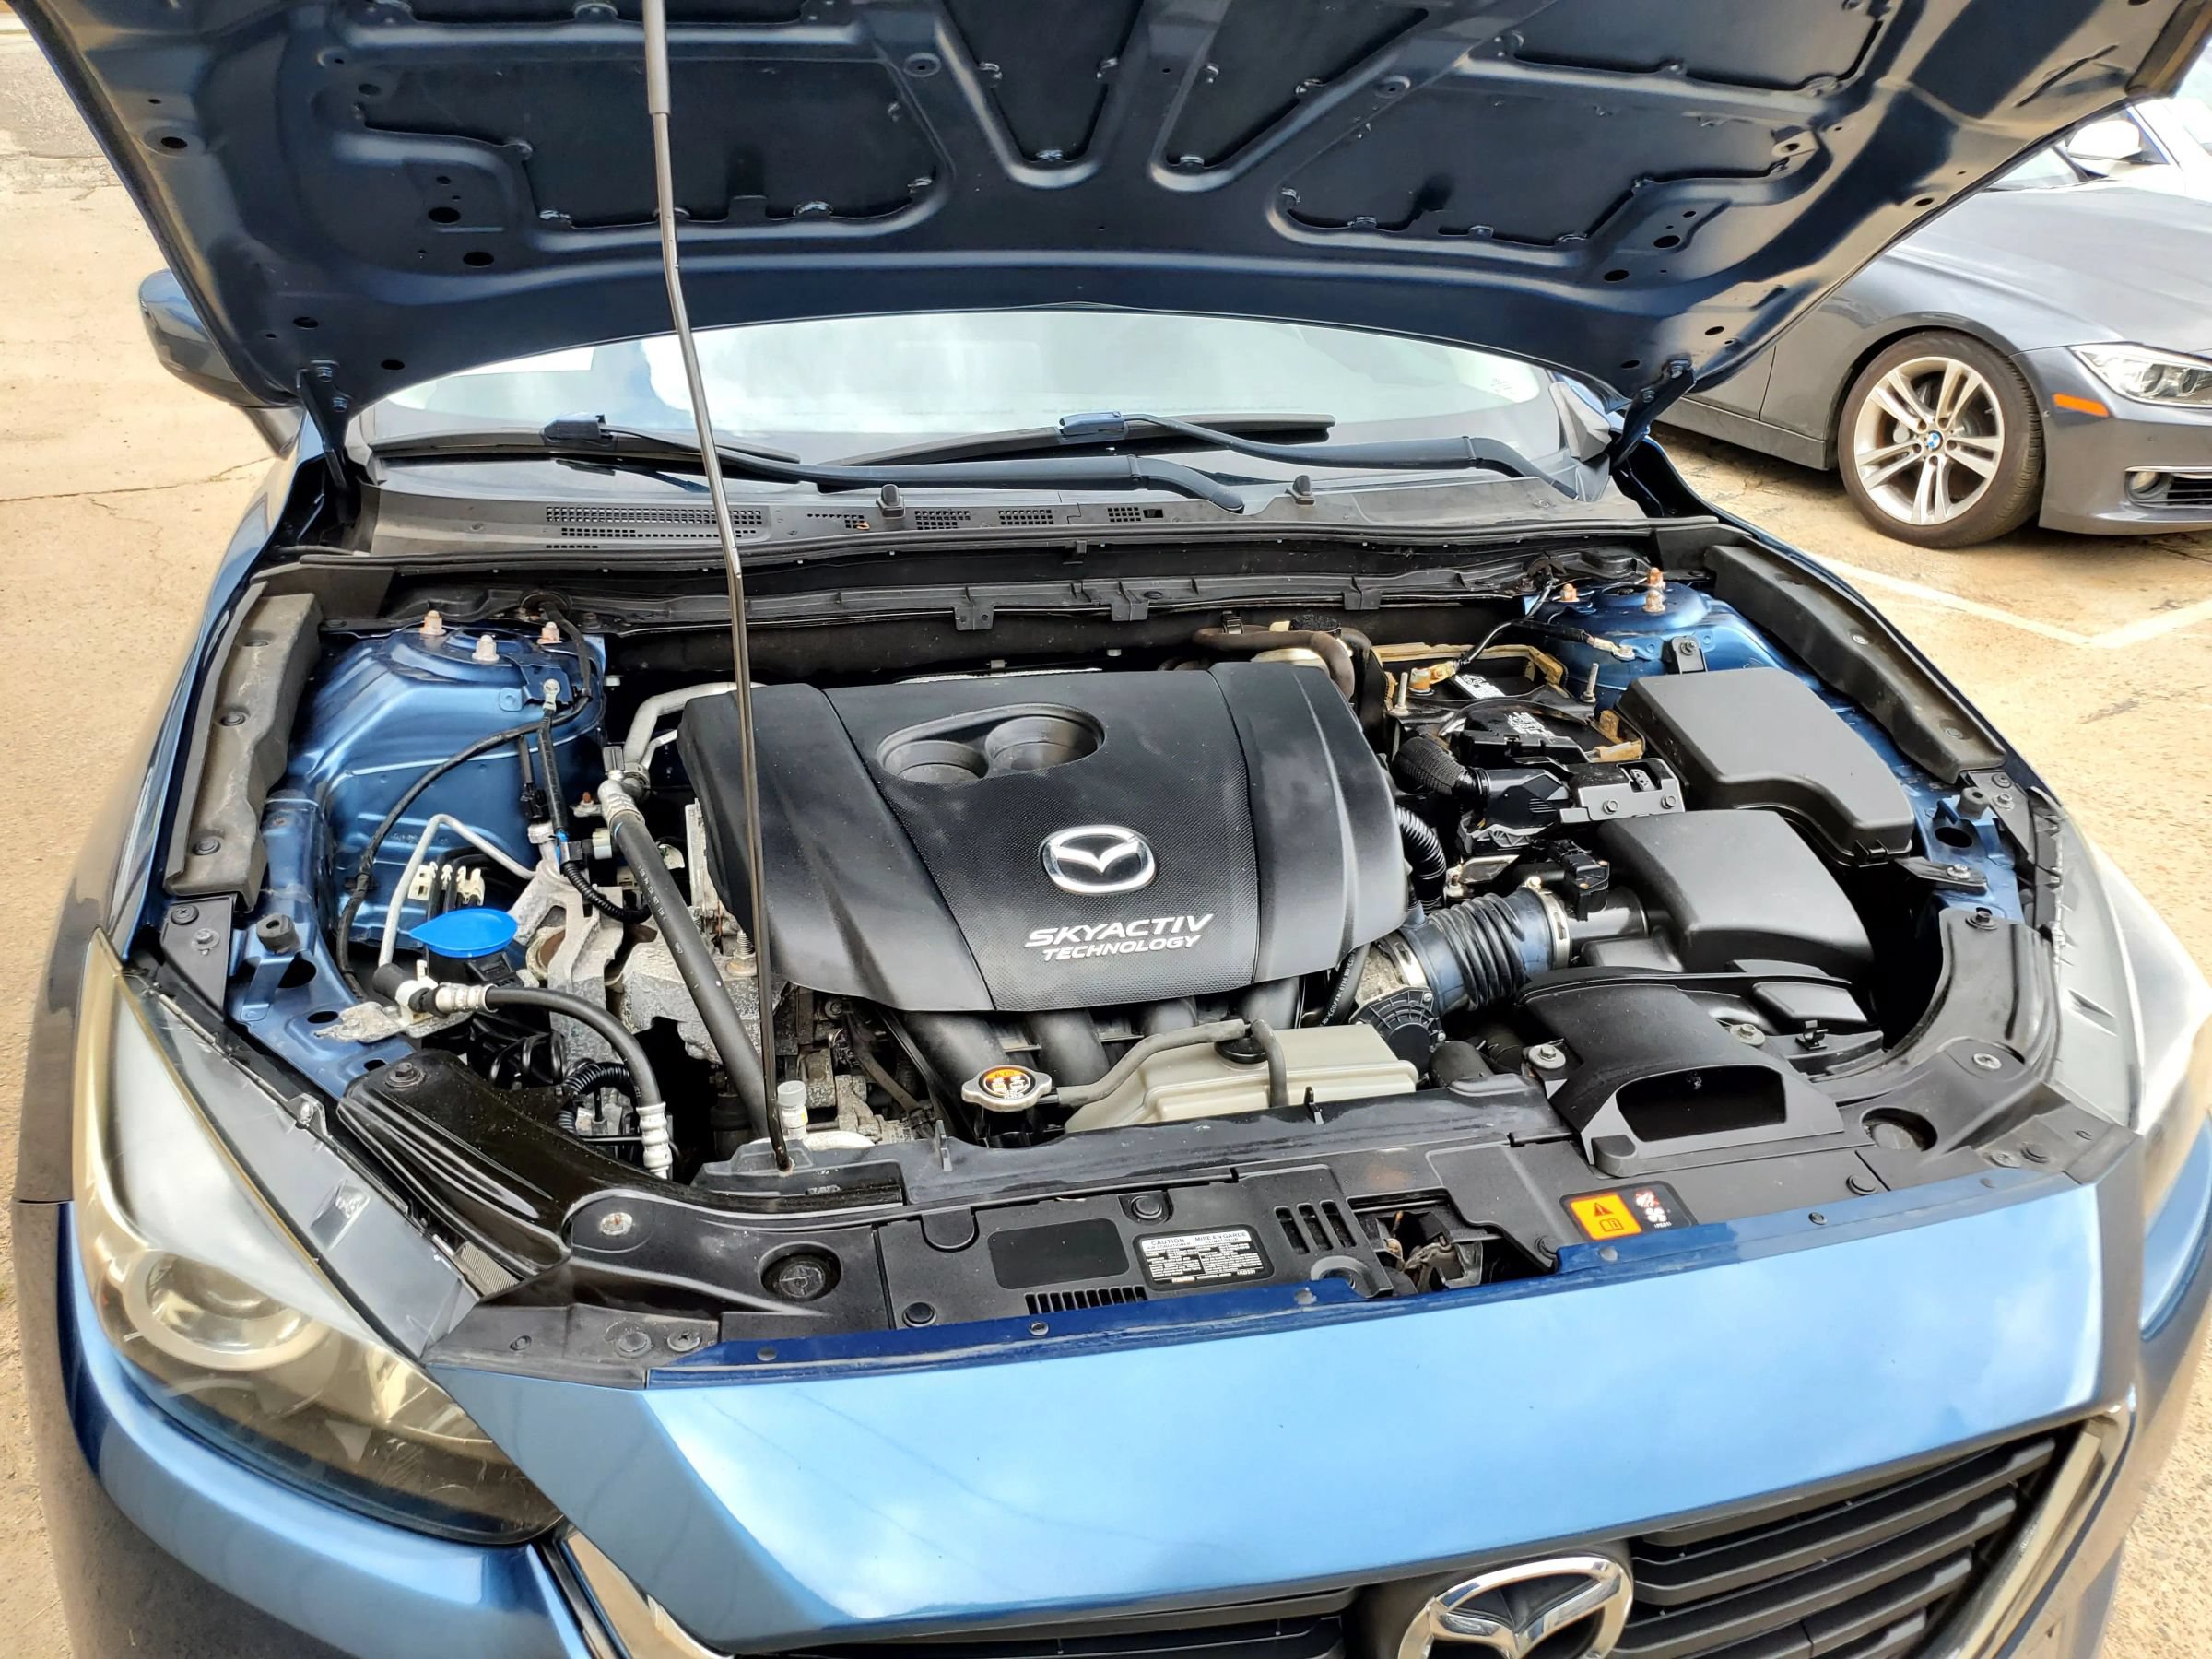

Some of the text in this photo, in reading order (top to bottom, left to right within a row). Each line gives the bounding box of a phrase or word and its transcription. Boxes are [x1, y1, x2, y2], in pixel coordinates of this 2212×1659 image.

[1025, 913, 1214, 948] SKYACTIV
[1042, 935, 1201, 962] TECHNOLOGY
[1150, 1238, 1185, 1246] CAUTION
